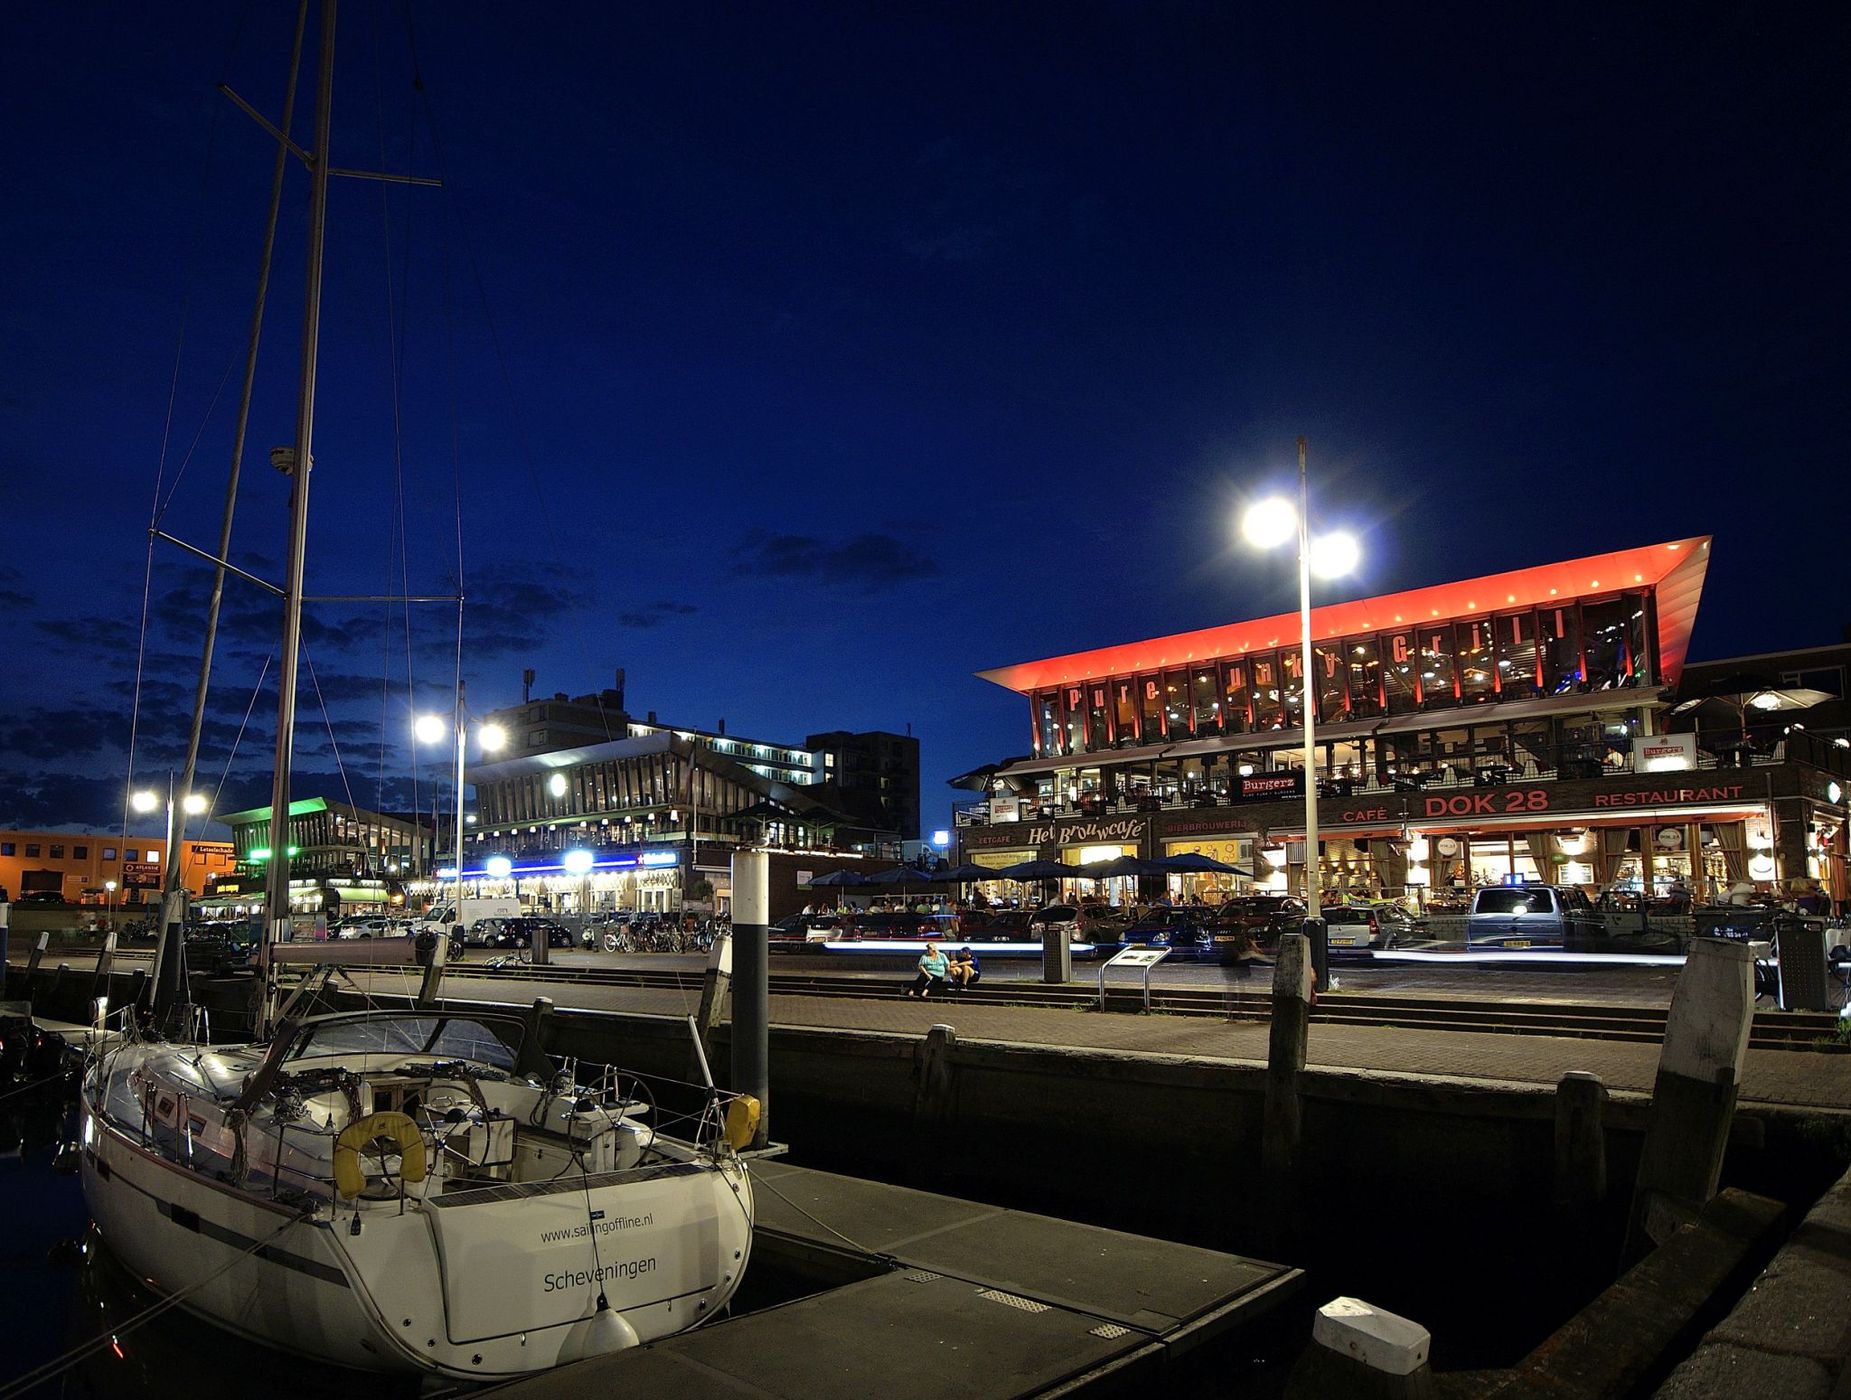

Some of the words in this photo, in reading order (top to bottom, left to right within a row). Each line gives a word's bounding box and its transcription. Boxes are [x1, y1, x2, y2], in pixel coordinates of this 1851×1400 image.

[1392, 609, 1565, 662] Grill
[1243, 779, 1295, 790] Burgerz
[1343, 806, 1388, 822] CAFÉ
[1424, 793, 1497, 817] DOK
[1504, 789, 1550, 812] 28
[1594, 786, 1744, 807] RESTAURANT
[1027, 825, 1055, 845] Het
[1058, 818, 1146, 845] Brouwcafé
[1167, 818, 1247, 833] BIERBROUWERIJ
[540, 1212, 654, 1243] www.sailngoffline.nl
[543, 1257, 656, 1293] Scheveningen
